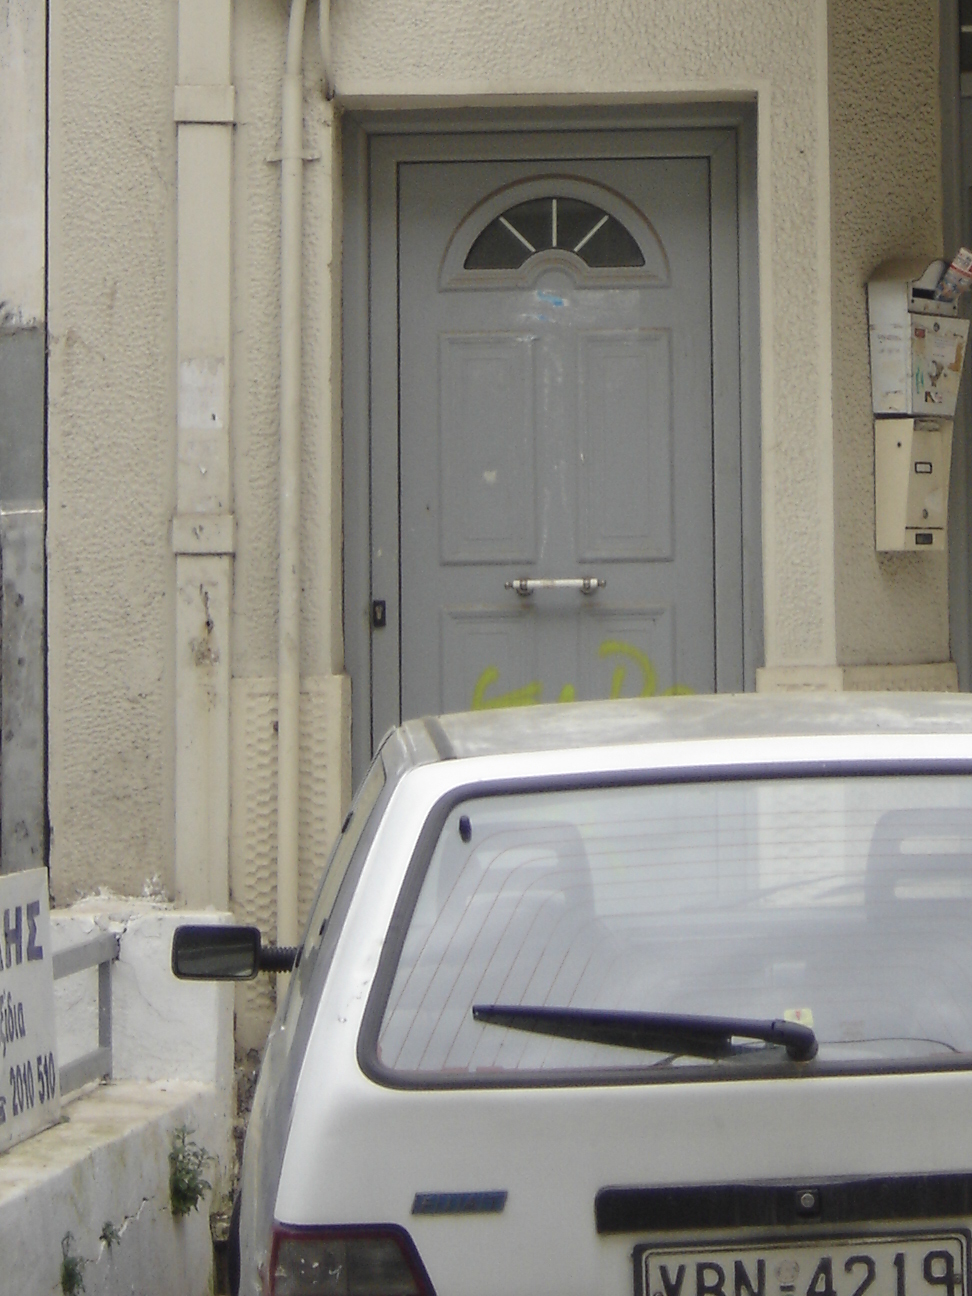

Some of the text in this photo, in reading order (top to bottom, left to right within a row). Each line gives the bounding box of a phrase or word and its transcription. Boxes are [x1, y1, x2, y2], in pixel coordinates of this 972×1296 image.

[0, 900, 43, 971] ΗΣ
[10, 1051, 56, 1116] 2010 510
